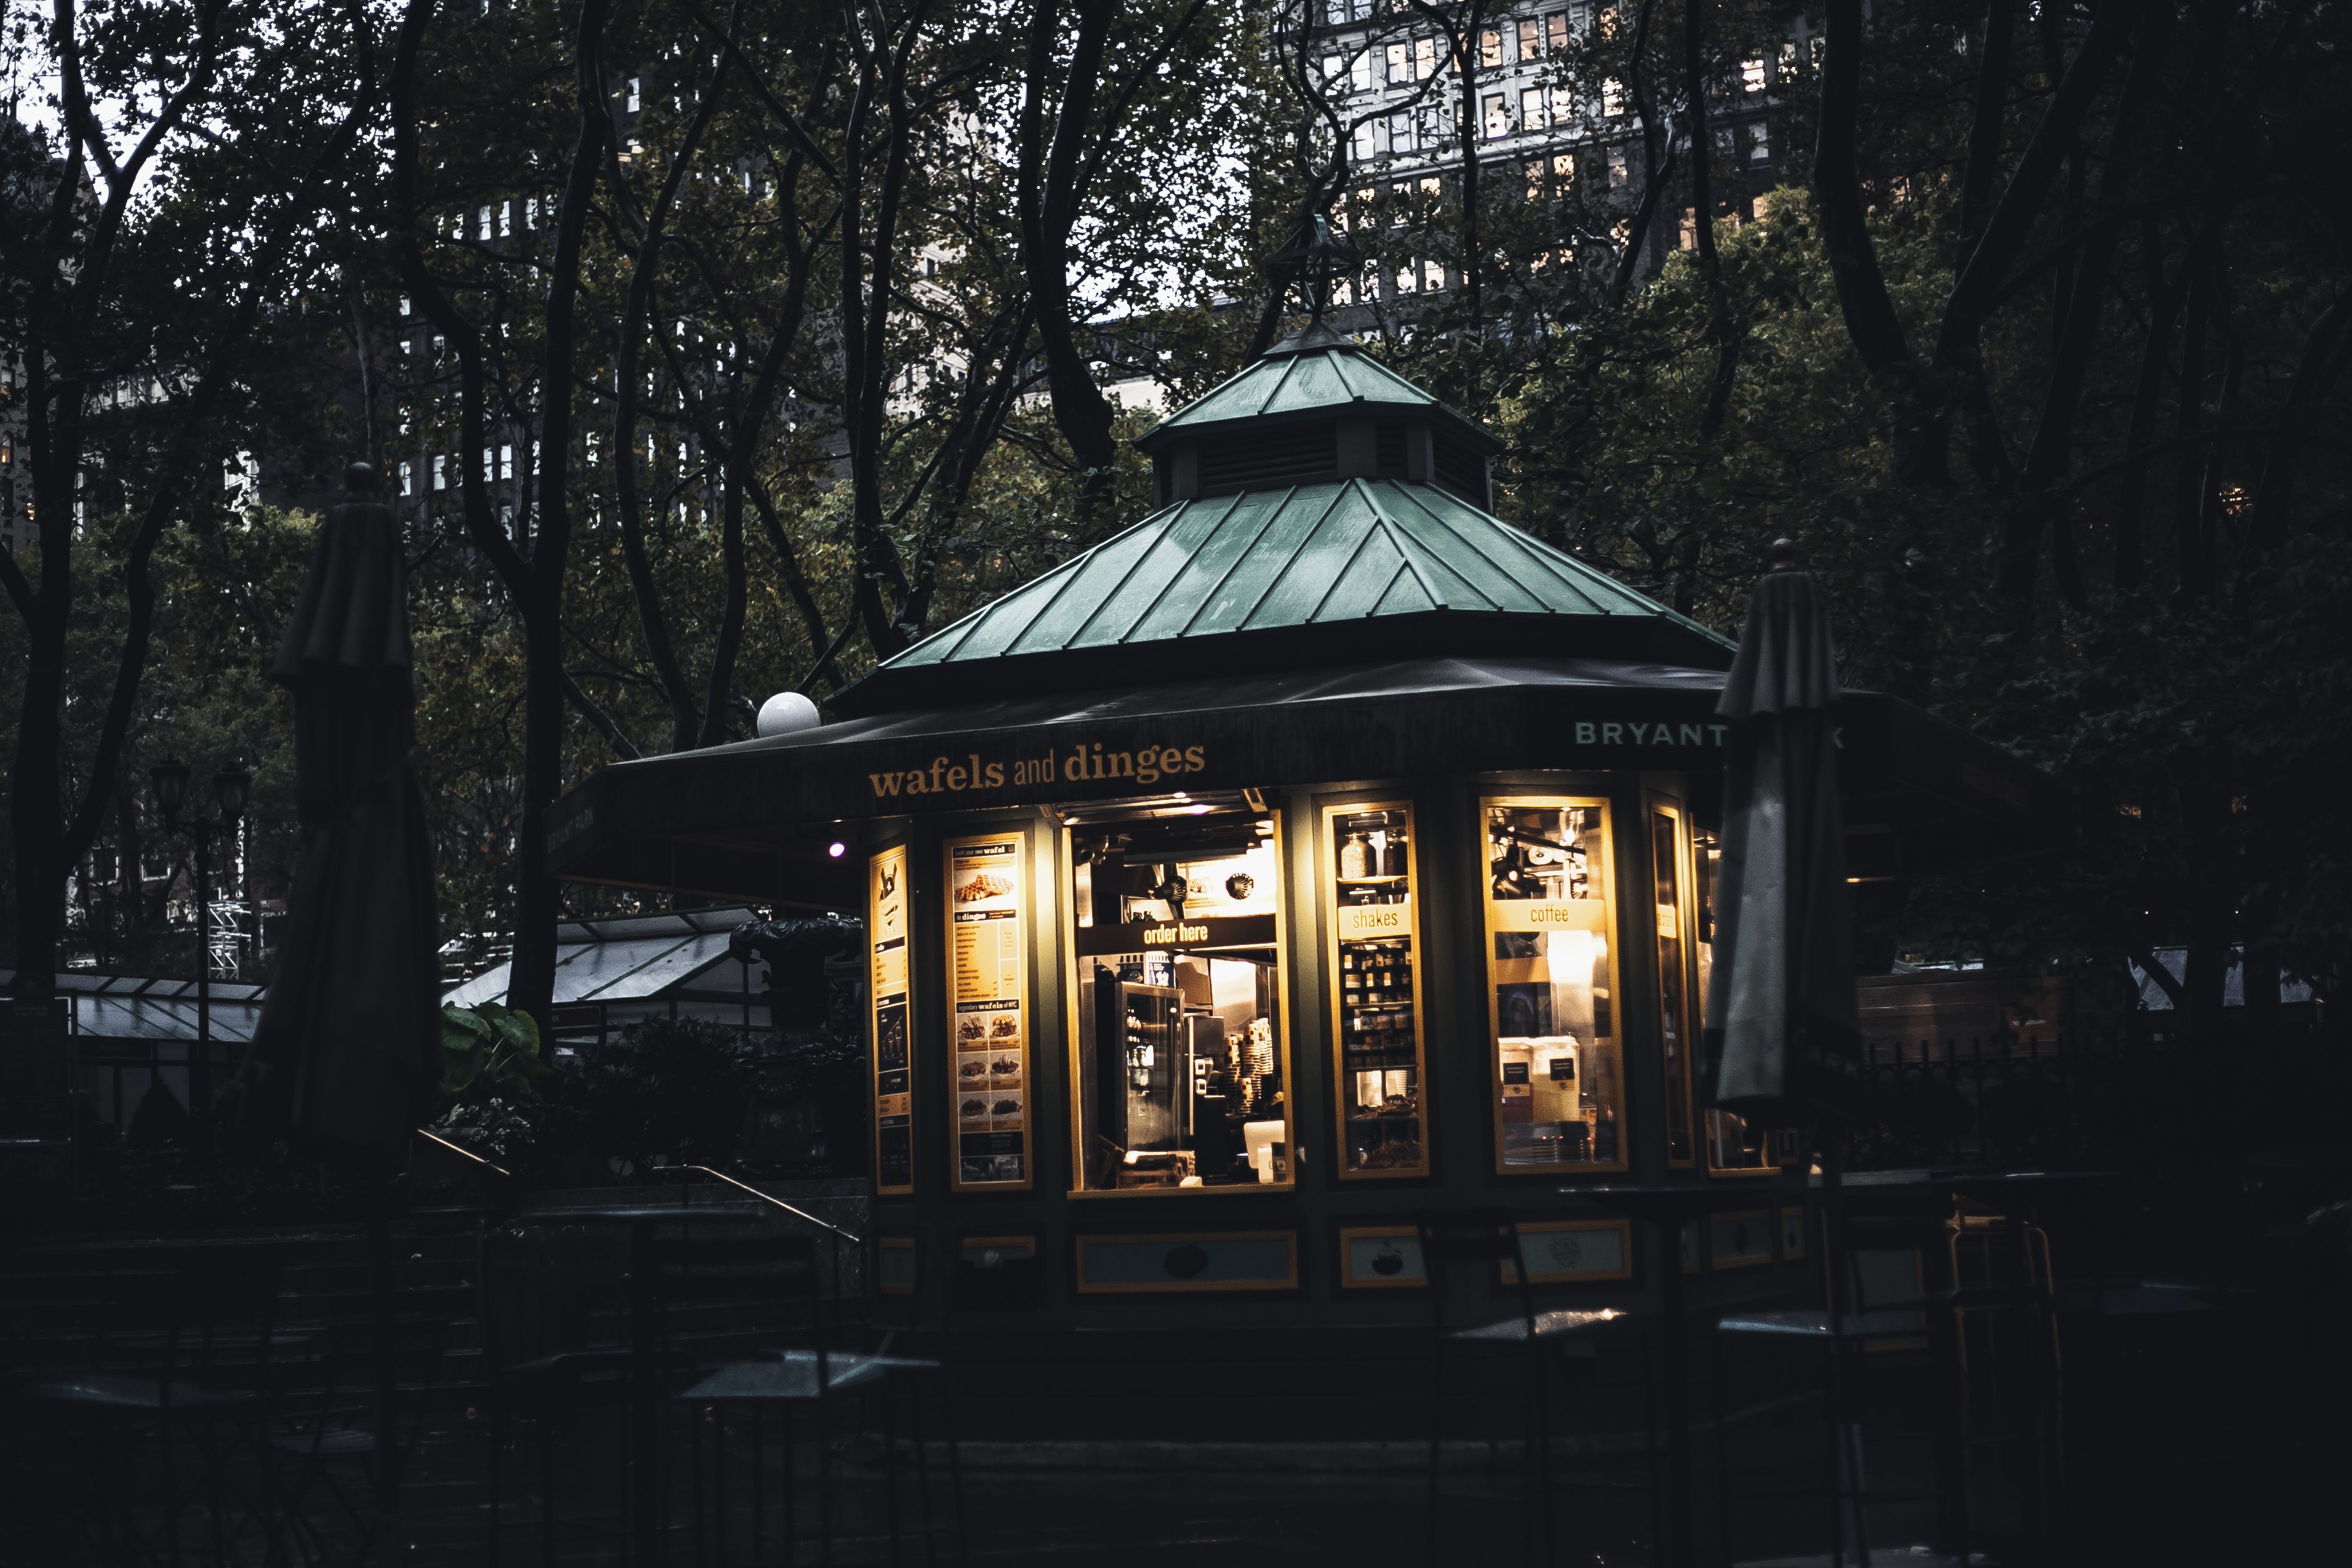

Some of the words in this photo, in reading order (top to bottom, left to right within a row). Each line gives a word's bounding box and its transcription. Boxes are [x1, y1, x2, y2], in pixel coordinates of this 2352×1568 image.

[1575, 722, 1729, 747] BRYANT
[869, 754, 1005, 797] wafels
[1014, 748, 1054, 785] and
[1064, 743, 1206, 785] dinges
[984, 846, 1005, 854] wafel
[962, 913, 986, 921] dinges
[1353, 909, 1398, 929] shakes
[1530, 904, 1569, 923] coffee
[1143, 923, 1178, 945] order
[1179, 921, 1208, 943] here
